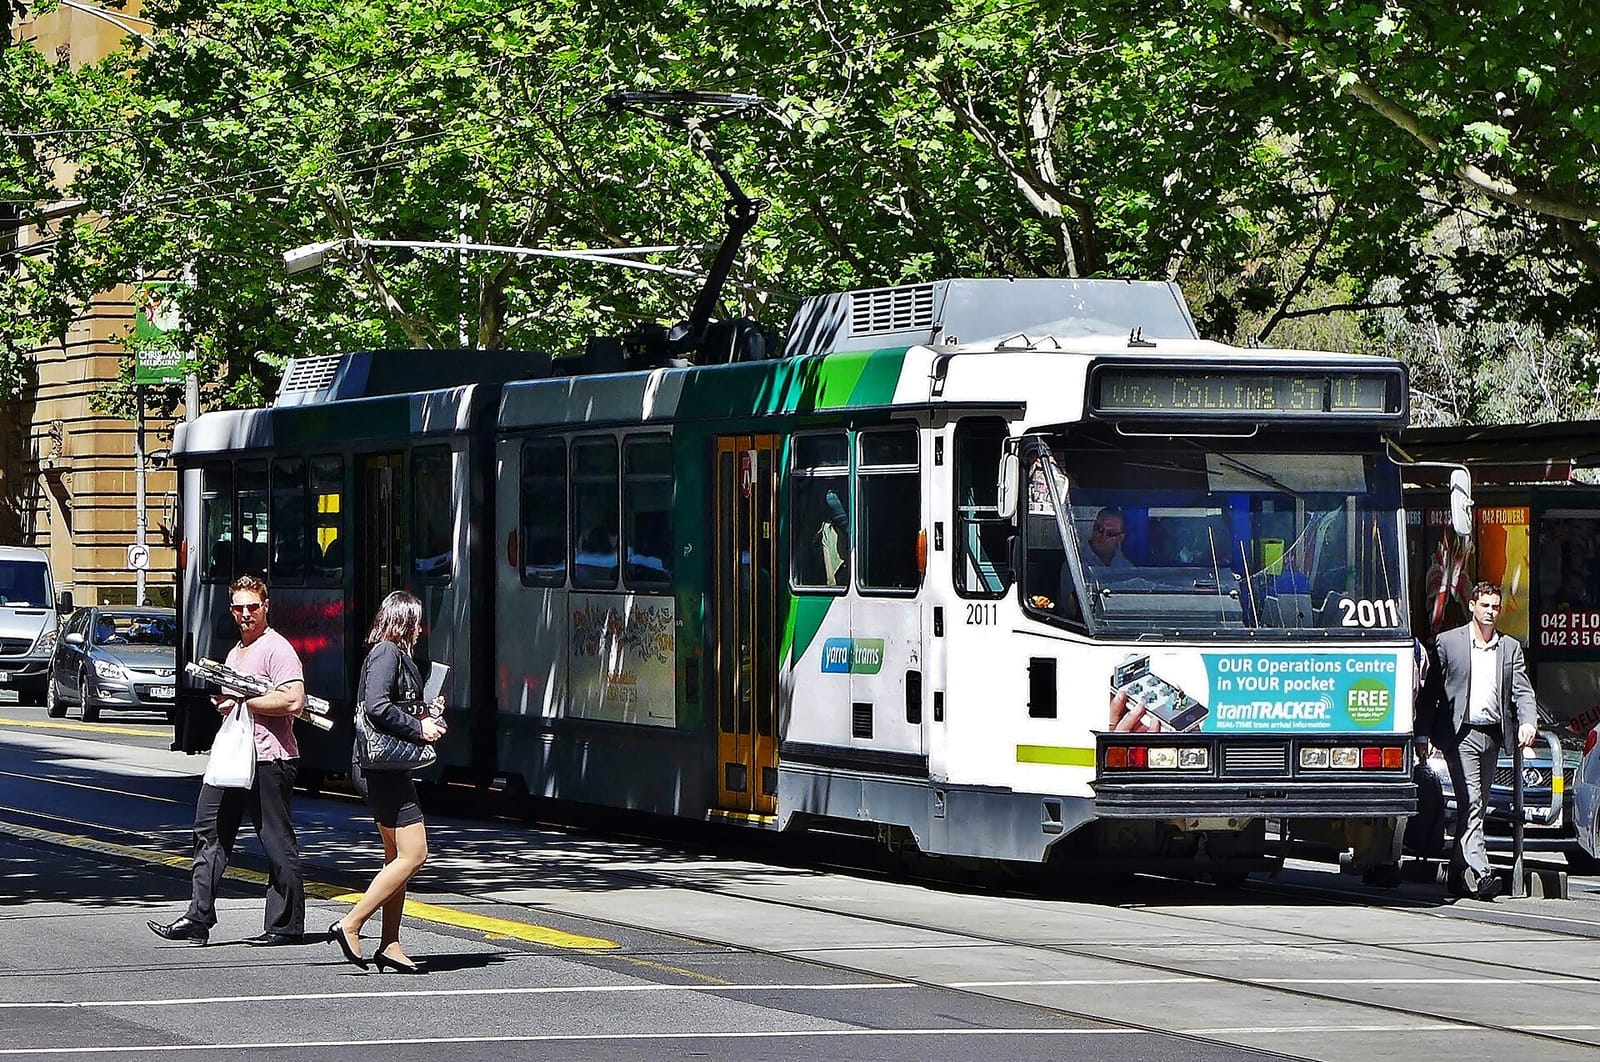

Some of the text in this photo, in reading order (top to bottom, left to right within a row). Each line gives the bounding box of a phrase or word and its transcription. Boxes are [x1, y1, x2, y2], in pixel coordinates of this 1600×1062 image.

[1482, 509, 1525, 525] 042 FLOWERS
[966, 603, 997, 626] 2011
[1339, 598, 1399, 628] 2011
[1541, 613, 1567, 628] 042
[1541, 631, 1567, 646] 042
[825, 646, 879, 668] yarra trams
[1217, 658, 1396, 676] OUR Operations Centre
[1217, 677, 1335, 694] in YOUR pocket
[1348, 689, 1389, 706] FREE
[1216, 701, 1326, 720] tramTRACKER
